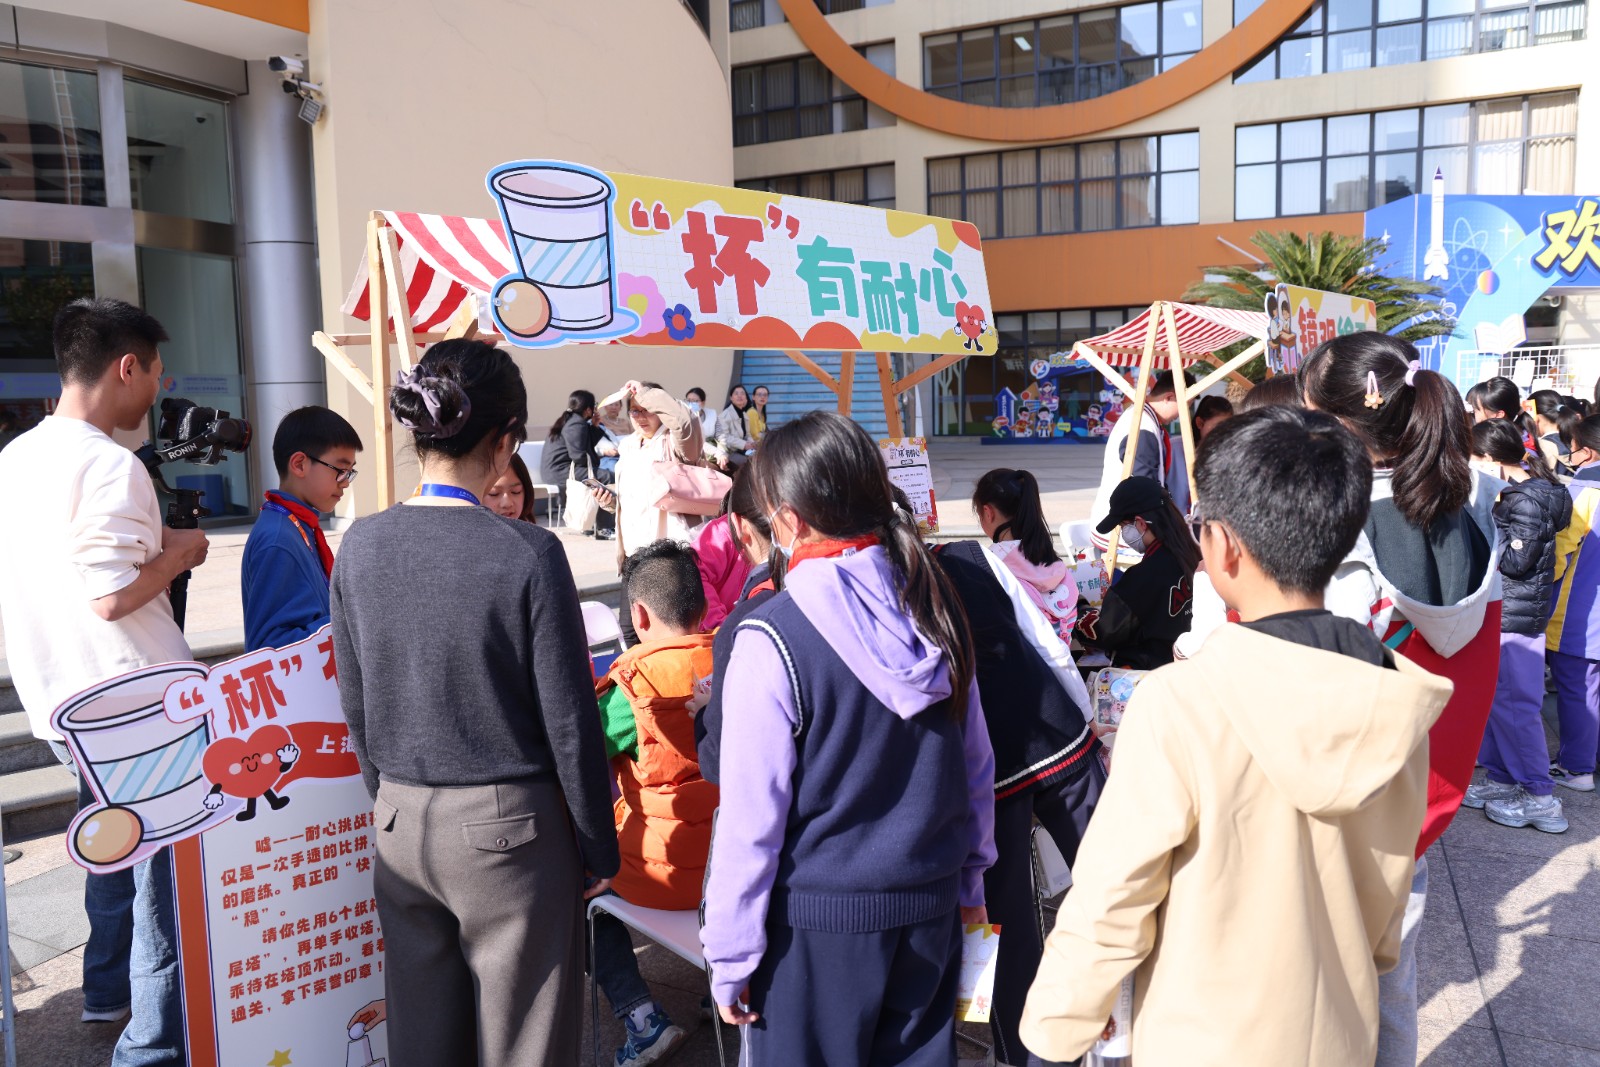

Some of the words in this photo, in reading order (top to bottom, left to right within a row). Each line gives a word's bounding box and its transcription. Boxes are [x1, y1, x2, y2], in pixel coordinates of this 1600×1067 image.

[630, 199, 967, 335] “杯”有耐心
[1535, 200, 1600, 274] 欢
[168, 443, 197, 459] RONIN
